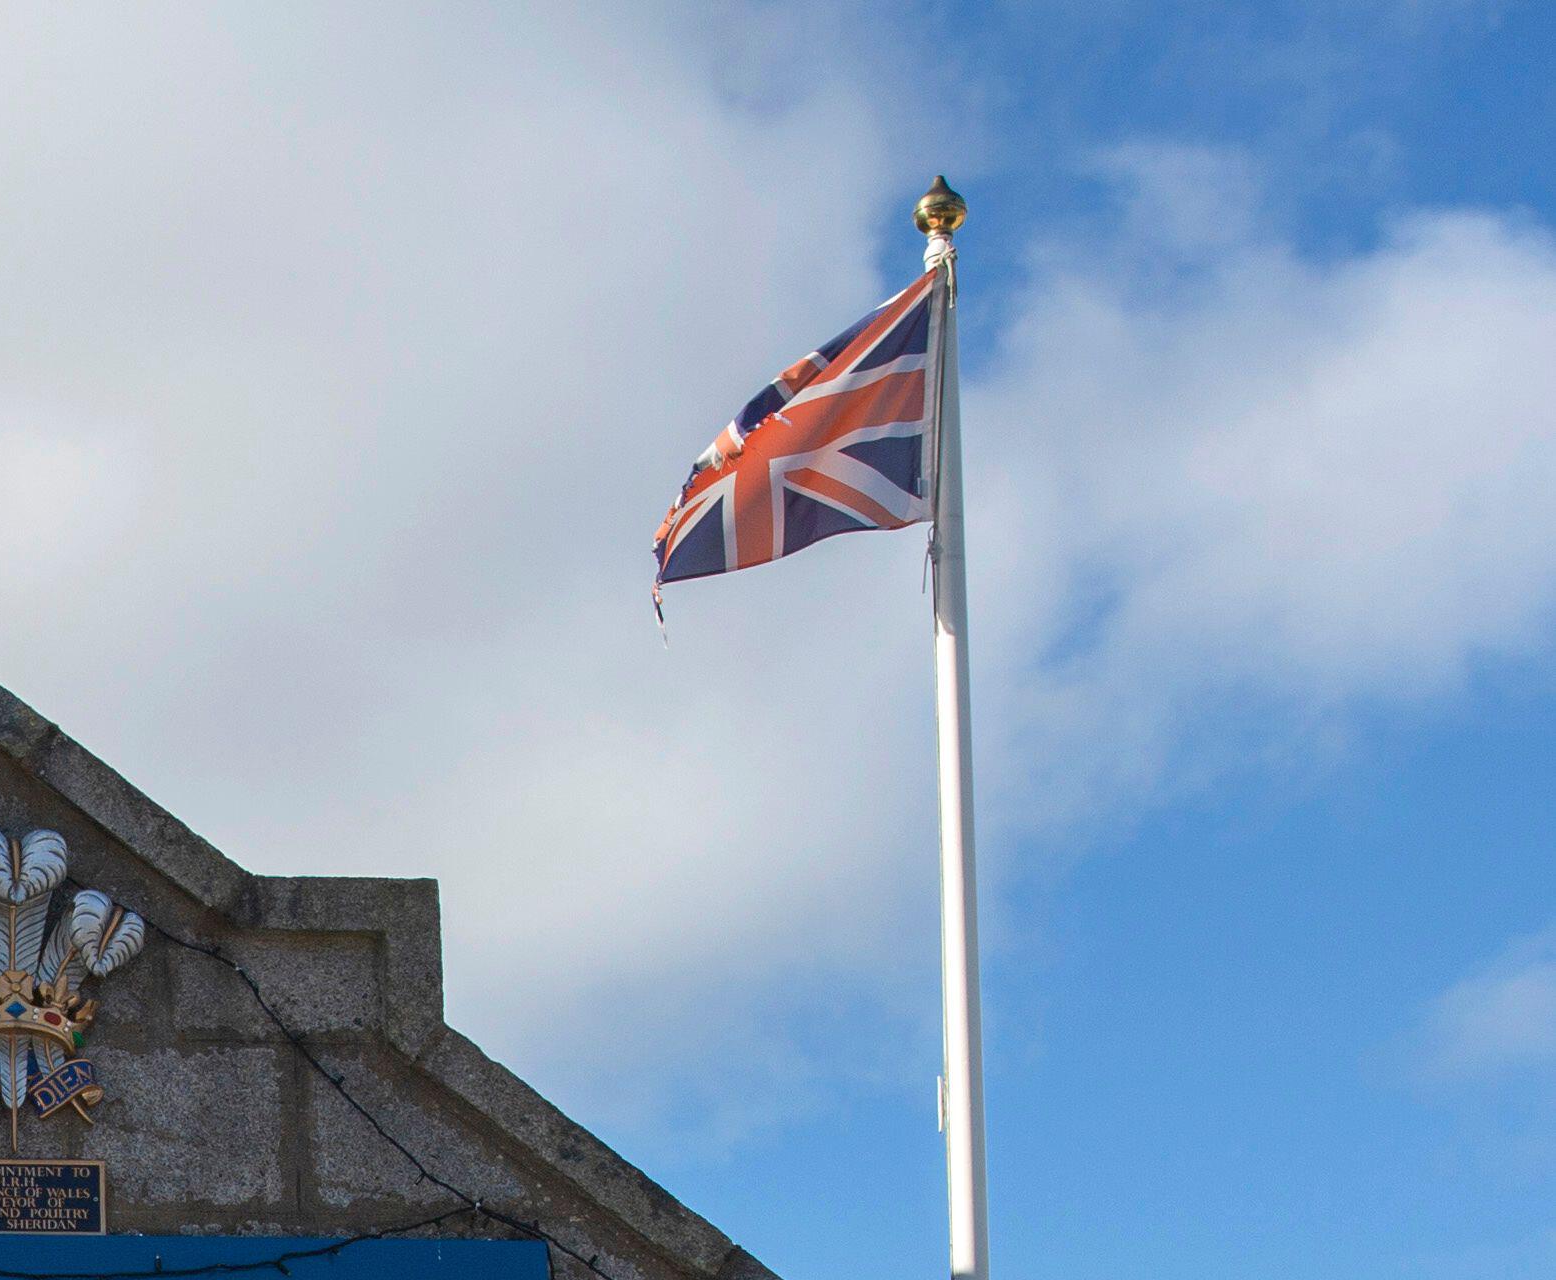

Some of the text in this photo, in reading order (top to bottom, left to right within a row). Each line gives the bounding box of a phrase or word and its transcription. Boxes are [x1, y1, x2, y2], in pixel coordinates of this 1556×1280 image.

[73, 1167, 90, 1177] TO
[25, 1187, 42, 1198] OF
[46, 1187, 90, 1199] WALES
[47, 1197, 64, 1208] OF
[30, 1208, 90, 1219] POULTRY
[7, 1218, 77, 1230] SHERIDAN
